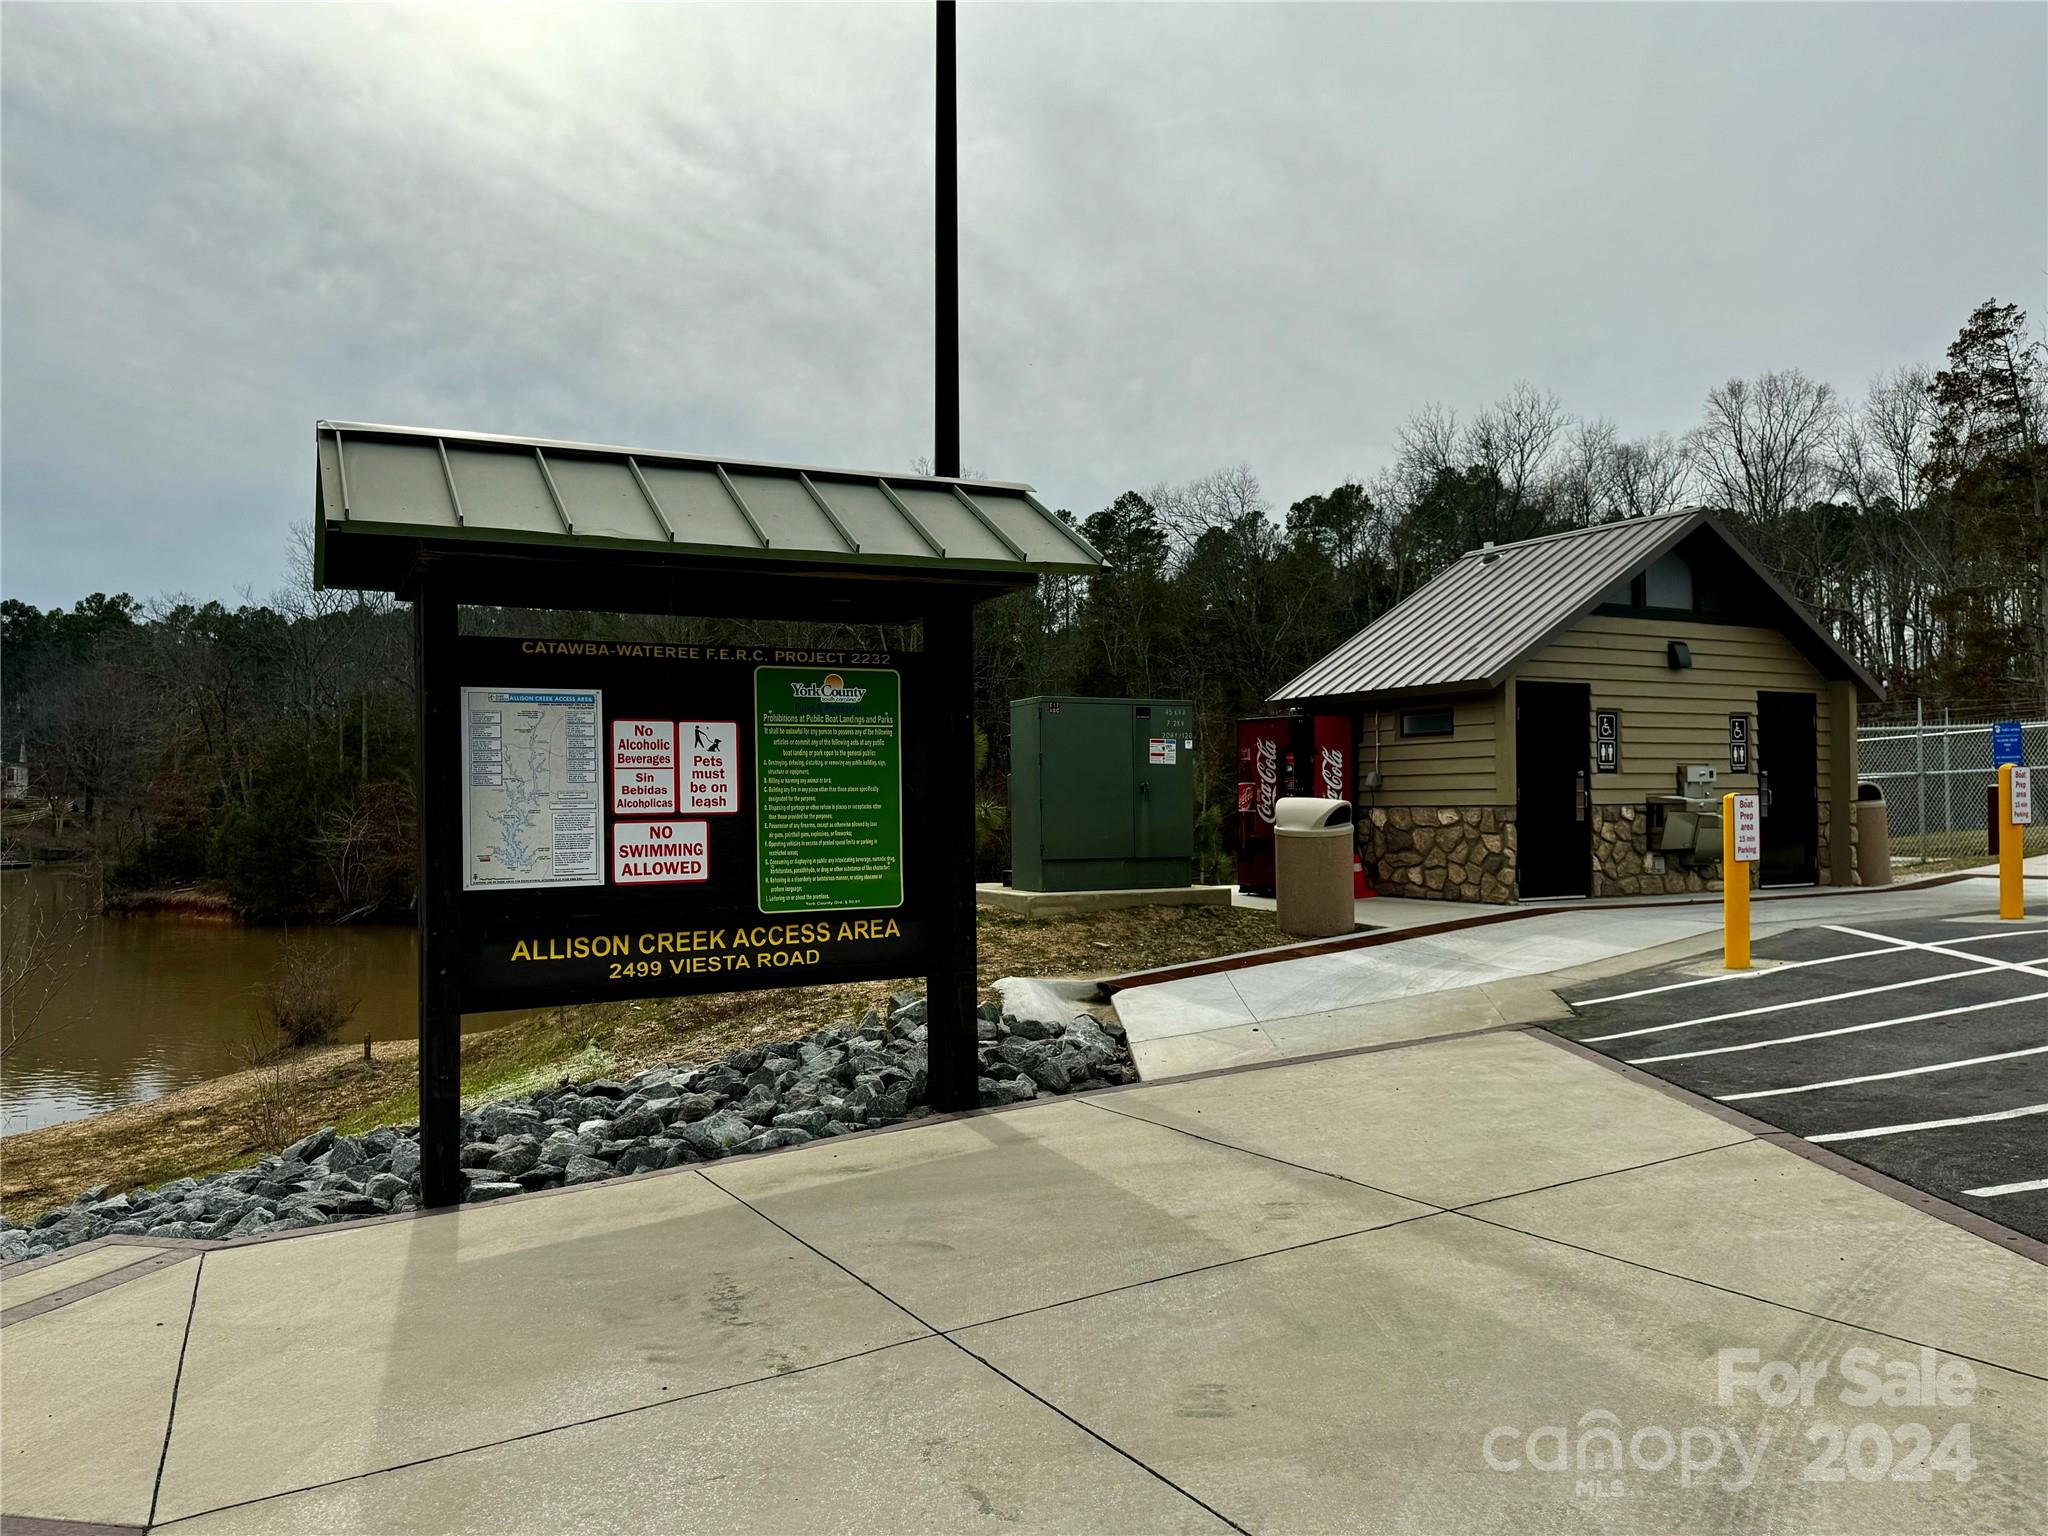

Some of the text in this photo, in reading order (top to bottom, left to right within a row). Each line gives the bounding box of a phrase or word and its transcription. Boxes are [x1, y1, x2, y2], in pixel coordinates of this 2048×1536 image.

[521, 641, 890, 665] CATAWBA-WATEREE F.E.R.C. PROJECT 2232
[791, 682, 866, 701] York County
[763, 714, 894, 725] Prohibitions at Public Boat Landings and Parks
[634, 725, 654, 737] No
[618, 739, 670, 750] Alcoholic
[618, 753, 671, 766] Beverages
[693, 756, 723, 767] Pets
[635, 772, 654, 782] Sin
[692, 769, 725, 779] must
[690, 782, 728, 793] be on
[2016, 781, 2026, 789] Prep
[622, 786, 668, 796] Bebidas
[616, 798, 673, 808] Alcoholicas
[692, 796, 726, 808] leash
[1740, 800, 1754, 808] Boat
[1740, 812, 1754, 821] Prep
[650, 826, 673, 839] NO
[618, 843, 704, 858] SWIMMING
[1738, 846, 1757, 854] Parking
[621, 860, 702, 876] ALLOWED
[511, 918, 901, 961] ALLISON CREEK ACCESS AREA
[609, 949, 821, 980] 2499 VIESTA ROAD
